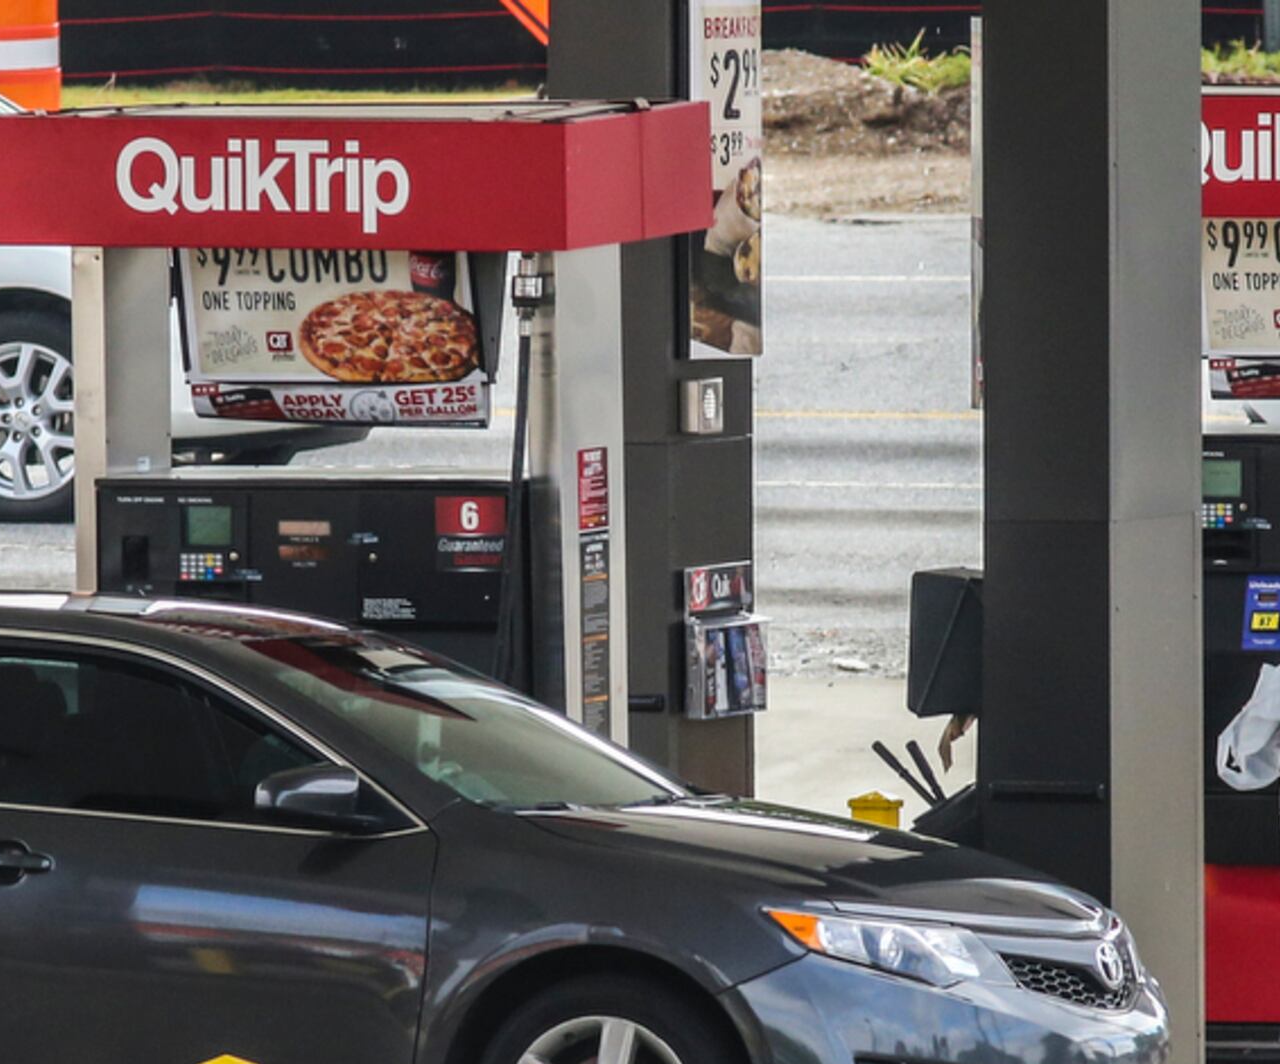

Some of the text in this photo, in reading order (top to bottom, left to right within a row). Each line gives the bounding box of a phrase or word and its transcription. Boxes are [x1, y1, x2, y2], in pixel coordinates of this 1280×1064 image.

[116, 137, 411, 234] QuikTrip
[267, 249, 388, 283] COMBO
[1212, 272, 1240, 291] ONE
[202, 291, 296, 311] ONE TOPPING
[271, 334, 288, 348] QT
[283, 394, 343, 407] APPLY
[394, 388, 438, 406] GET
[285, 408, 347, 420] TODAY
[426, 404, 477, 416] GALLON
[460, 501, 479, 531] 6
[437, 538, 504, 552] Guaranteed
